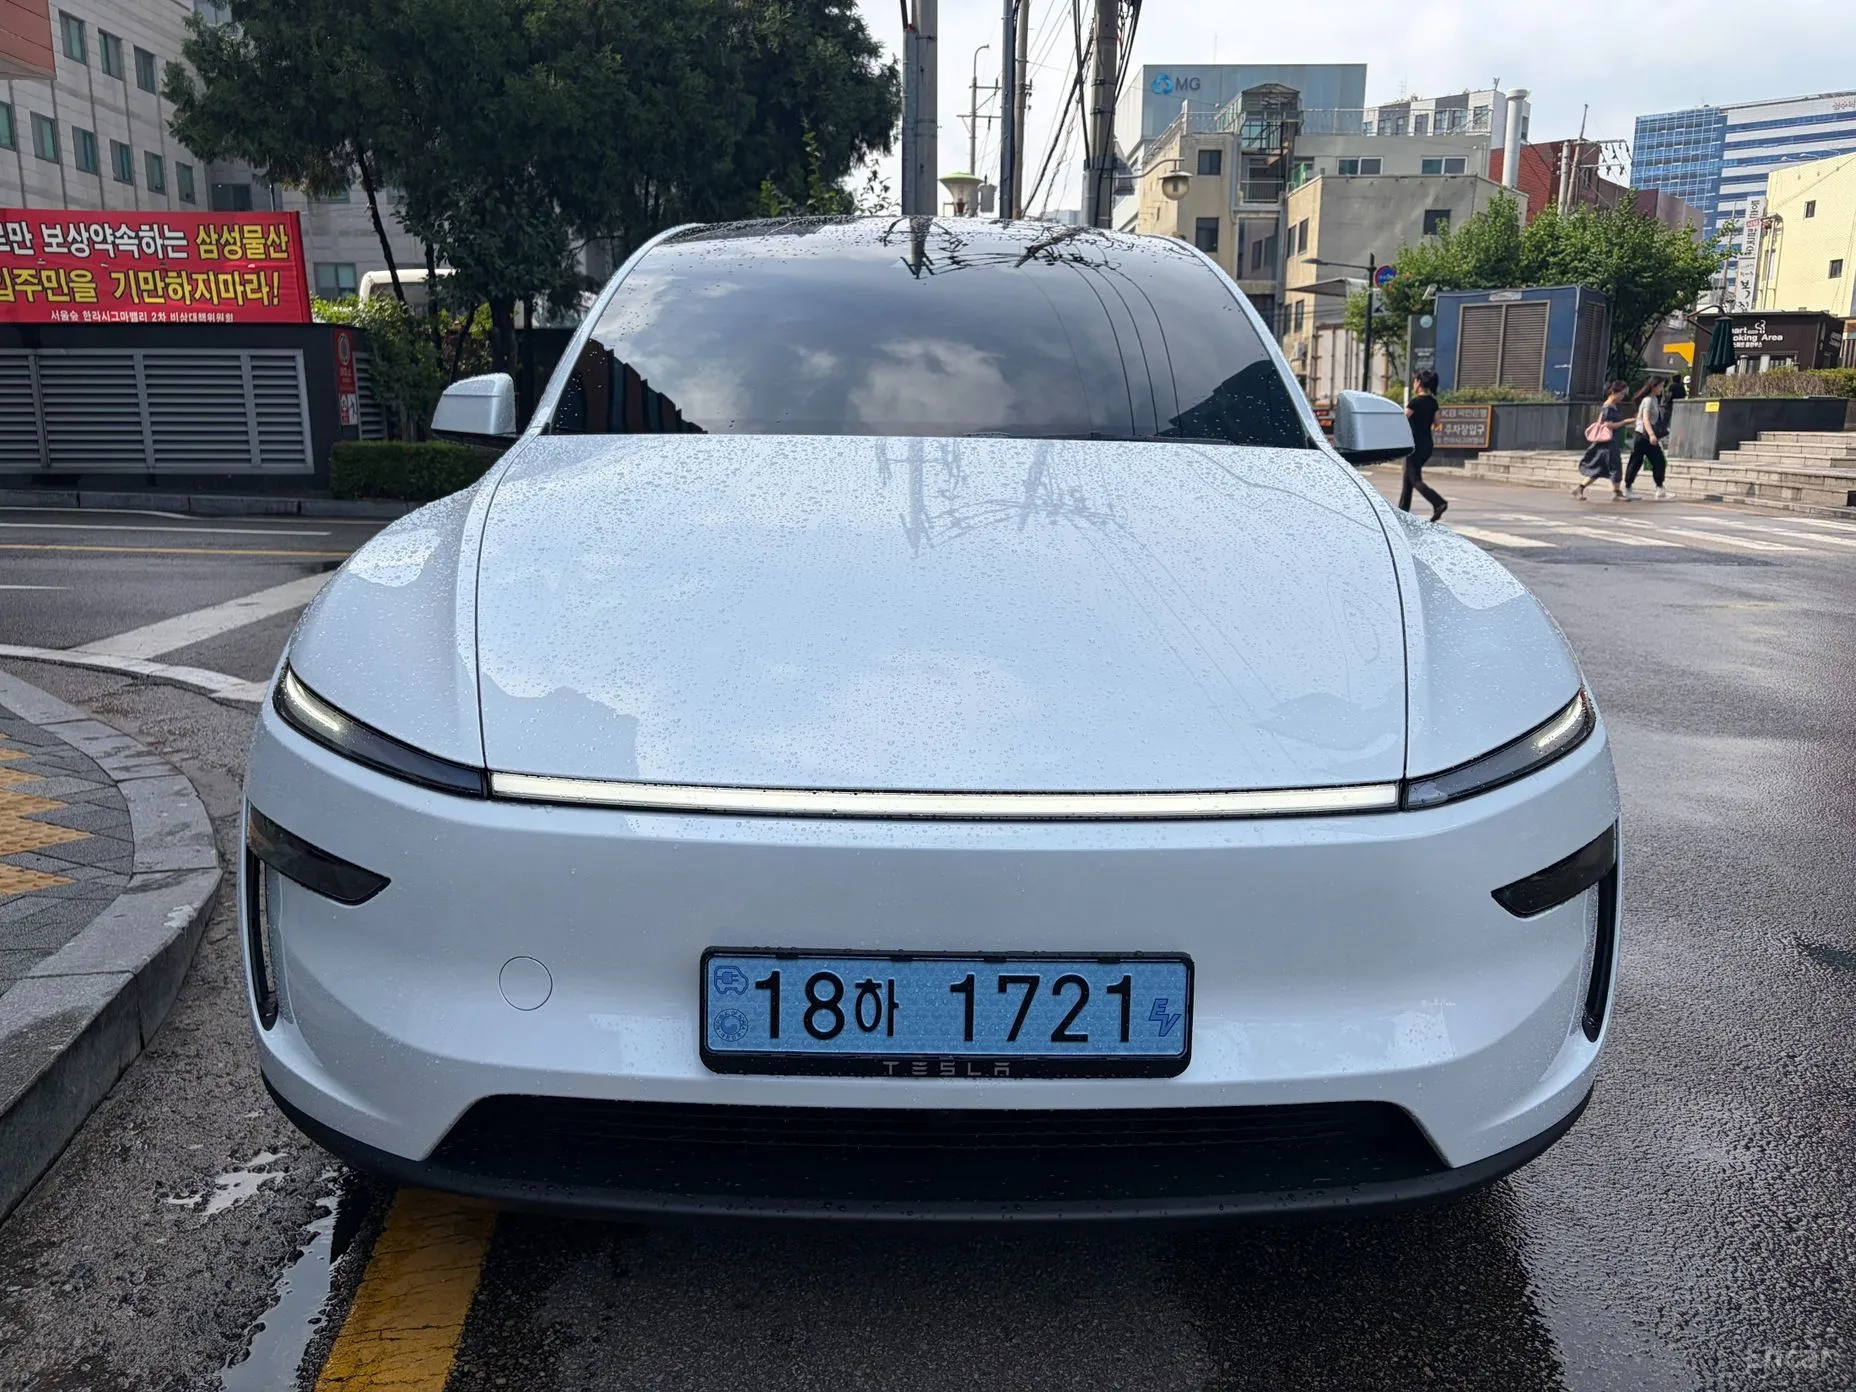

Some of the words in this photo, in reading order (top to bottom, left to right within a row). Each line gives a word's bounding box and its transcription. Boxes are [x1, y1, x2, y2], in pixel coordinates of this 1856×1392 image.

[1175, 77, 1200, 92] MG
[40, 222, 189, 259] 보상약속하는
[196, 223, 289, 261] 삼성물산
[110, 269, 281, 306] 기만하지마라!
[51, 310, 79, 322] 서울숲
[151, 312, 167, 323] 2차
[1731, 326, 1748, 334] art
[1732, 334, 1758, 343] oking
[1761, 333, 1784, 341] Area
[754, 970, 900, 1042] 18하
[949, 973, 1132, 1043] 1721
[1148, 997, 1182, 1038] EV
[882, 1060, 1011, 1077] TESLA
